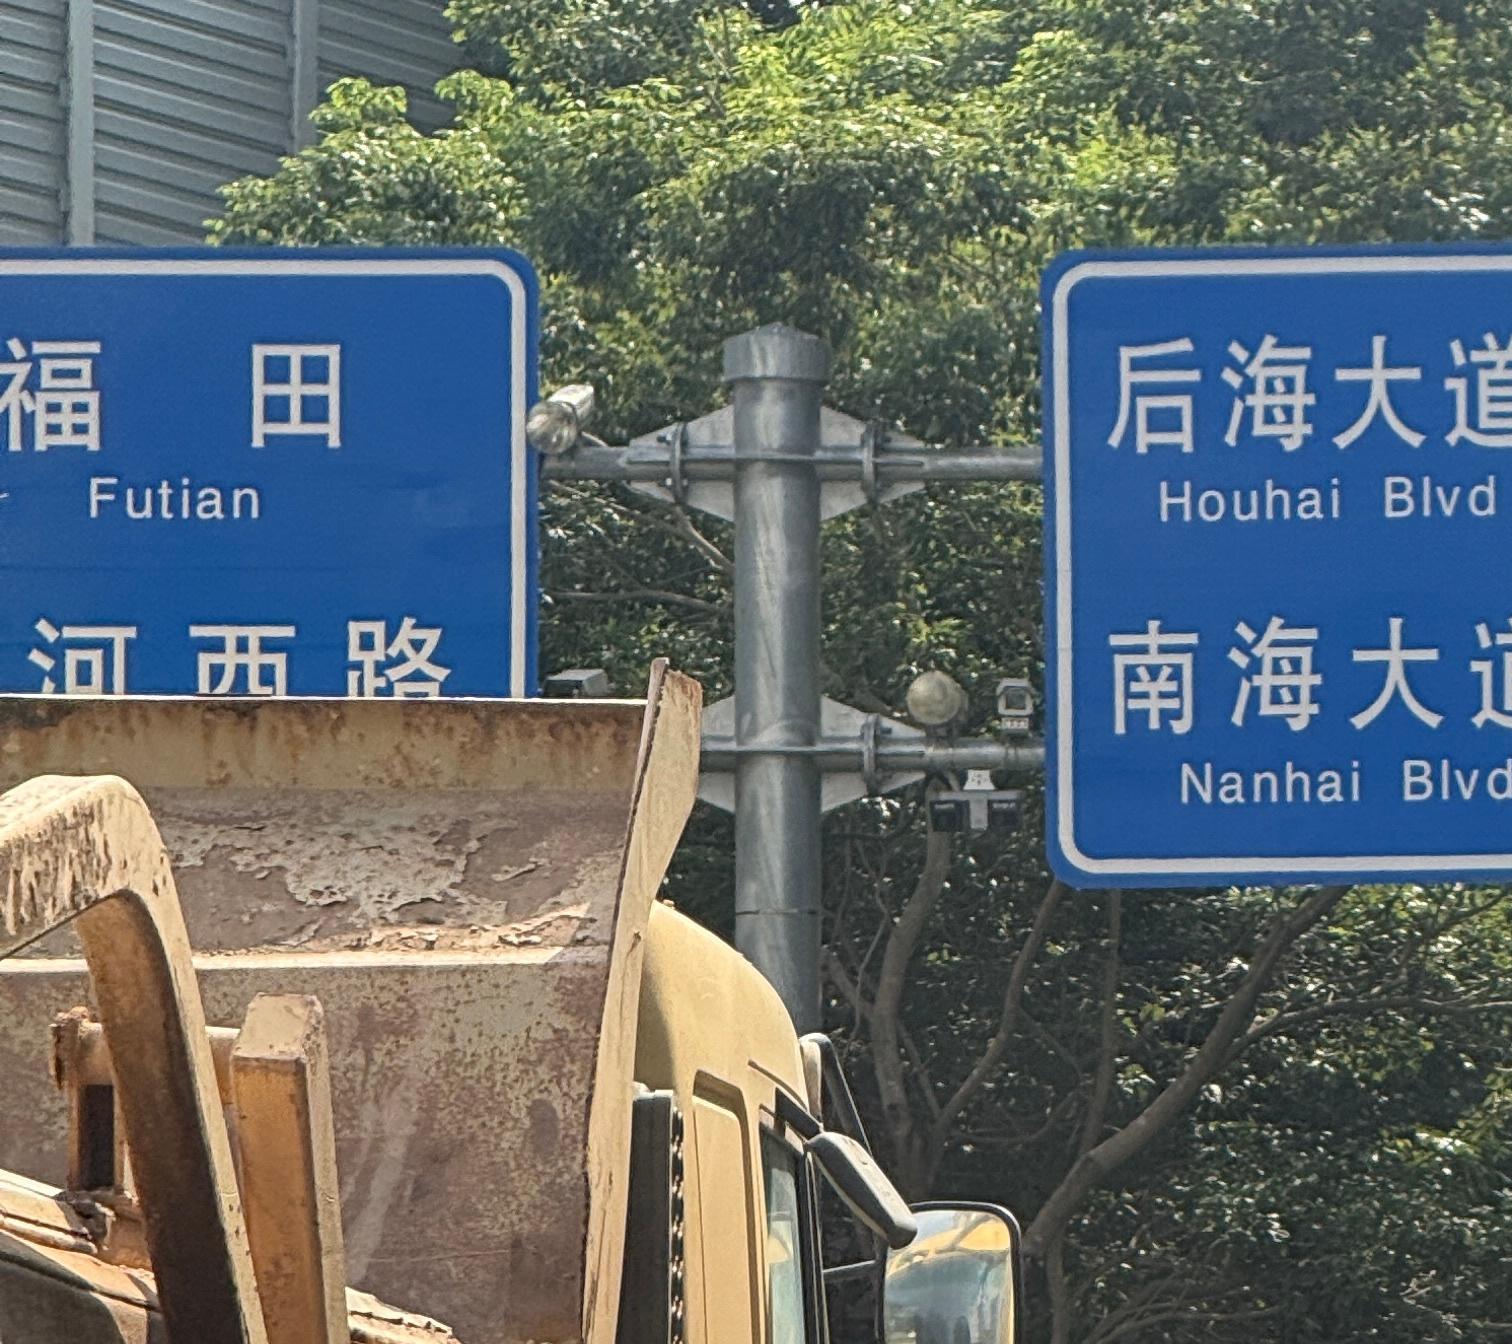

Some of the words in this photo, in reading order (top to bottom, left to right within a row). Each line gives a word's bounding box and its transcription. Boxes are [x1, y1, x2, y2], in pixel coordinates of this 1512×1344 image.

[0, 337, 342, 452] 福田
[89, 476, 260, 520] Futian
[1159, 477, 1341, 522] Houhai
[1384, 475, 1498, 518] Blvd
[27, 616, 452, 696] 河西路
[1180, 760, 1361, 804] Nanhai
